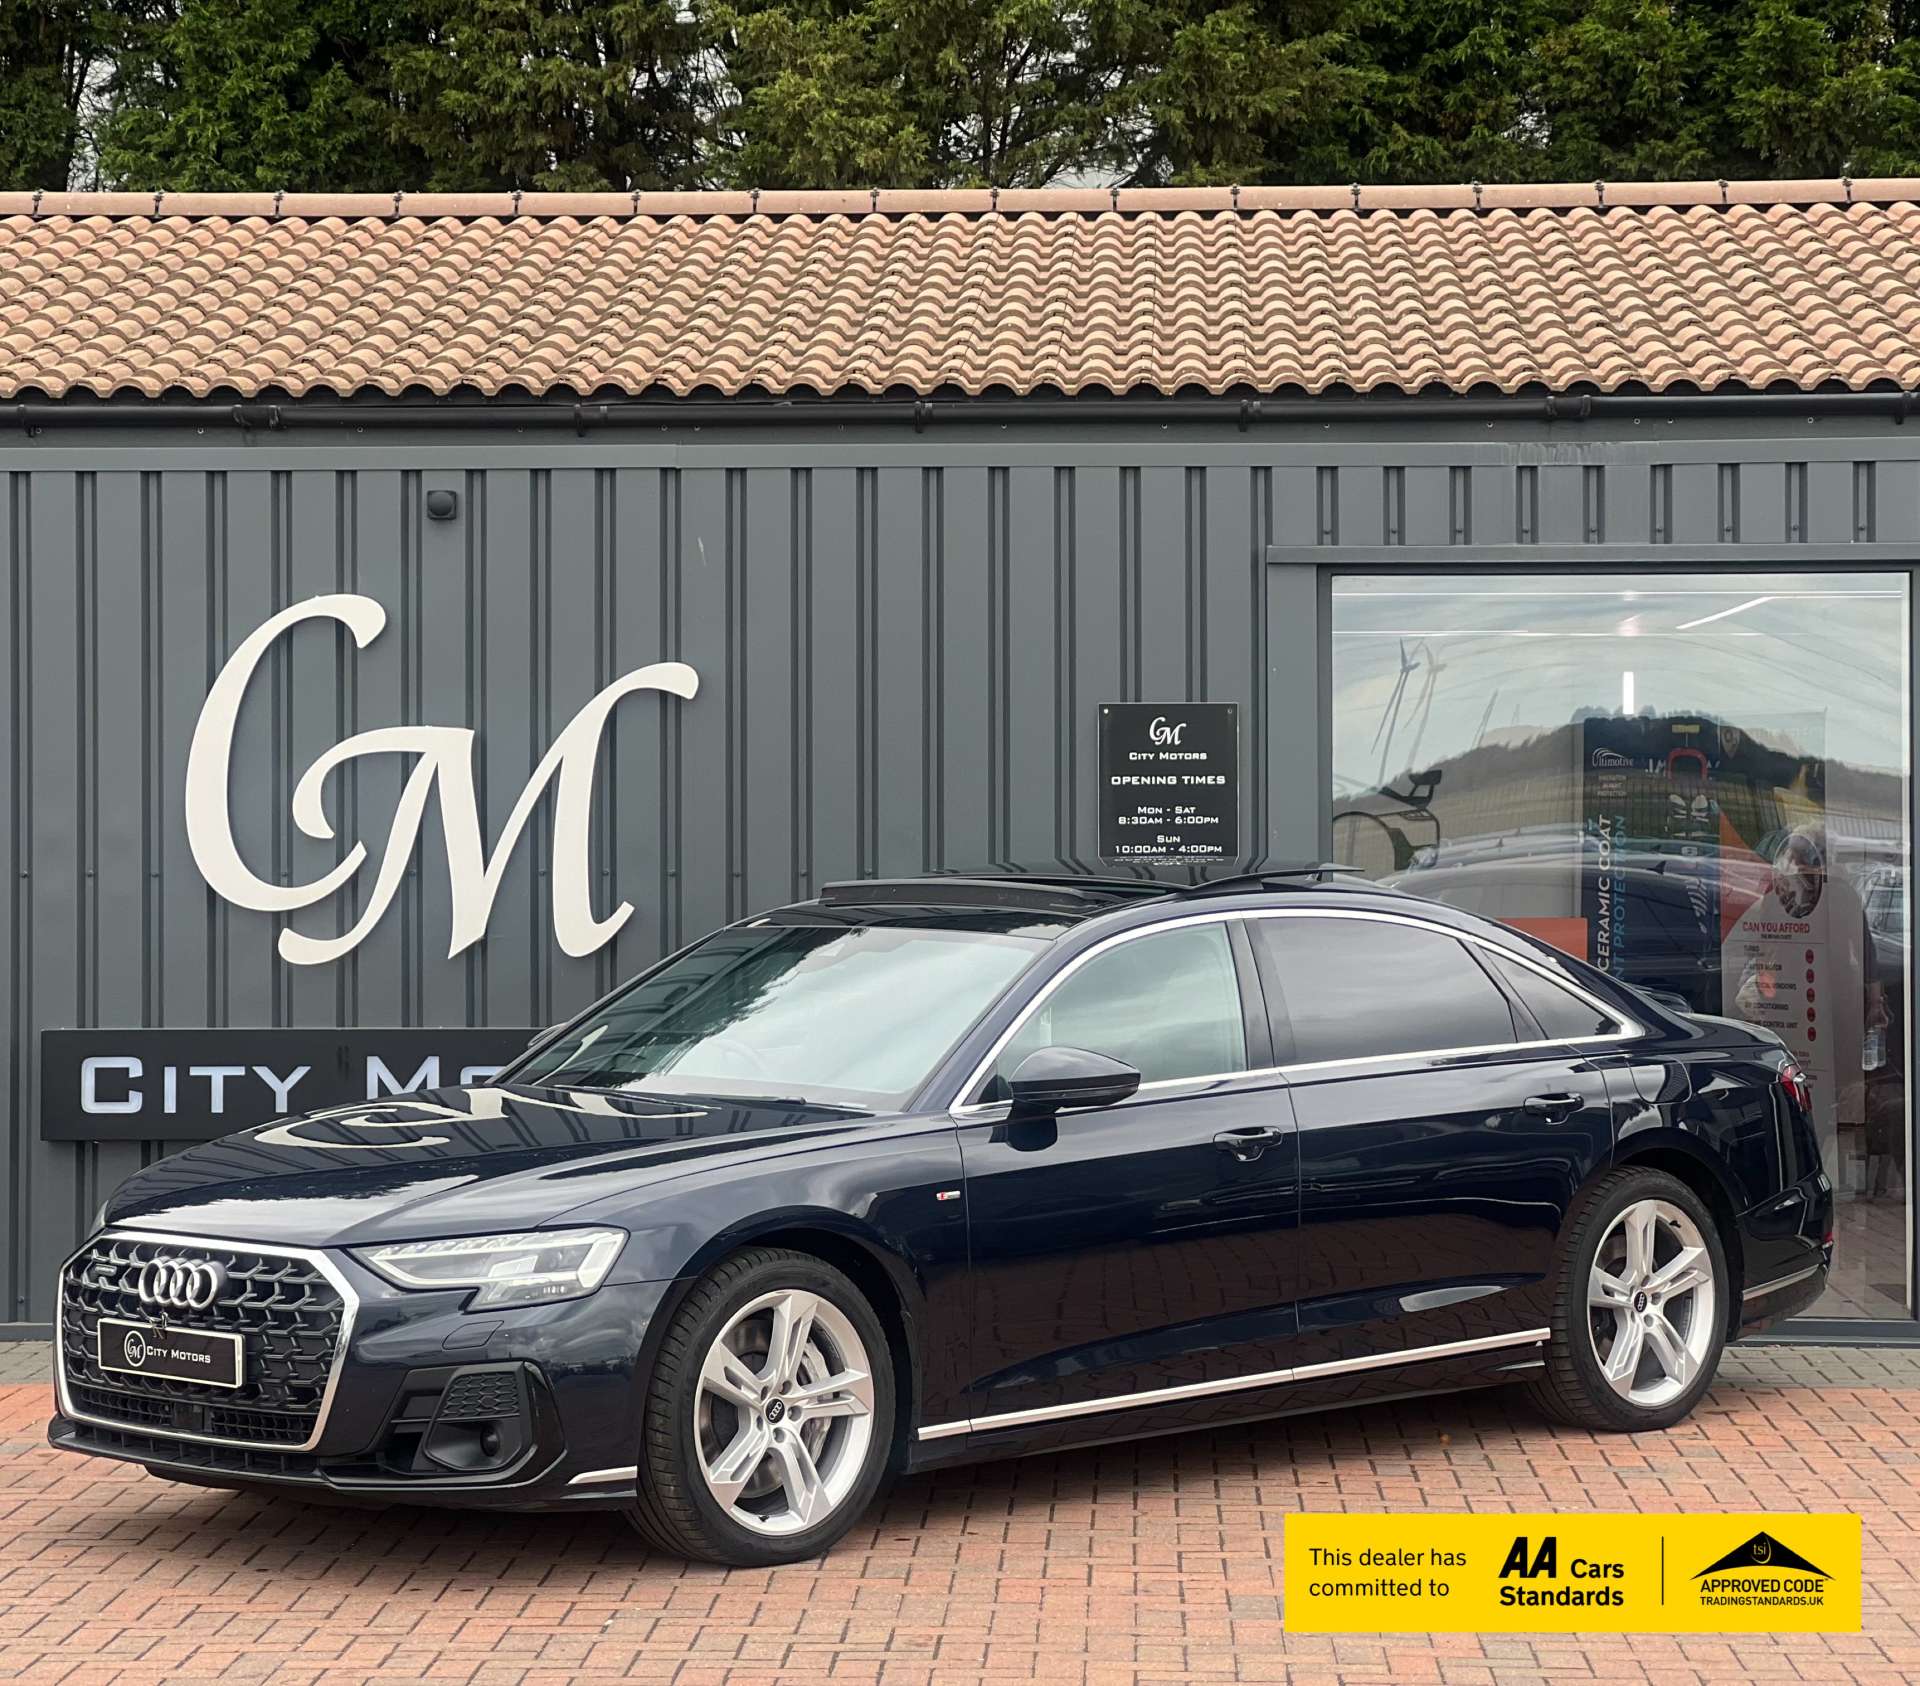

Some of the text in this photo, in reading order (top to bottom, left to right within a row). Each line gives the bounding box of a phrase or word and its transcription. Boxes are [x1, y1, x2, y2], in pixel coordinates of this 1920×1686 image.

[1129, 752, 1208, 760] CITY MOTORS
[1111, 775, 1226, 785] OPENING TIMES
[1137, 806, 1163, 814] MON
[1174, 806, 1196, 814] SAT
[1118, 816, 1163, 825] 8:30AM
[1174, 816, 1219, 824] 6:00PM
[1156, 835, 1181, 843] SUN
[1115, 845, 1167, 854] 10:00AM
[1178, 845, 1222, 853] 4:00PM
[1613, 815, 1627, 949] PROTECTION
[1597, 814, 1612, 972] CERAMIC COAT
[1743, 921, 1810, 934] CAN YOU AFFORD
[81, 1056, 311, 1114] CITY
[146, 1345, 211, 1363] CITY MOTORS
